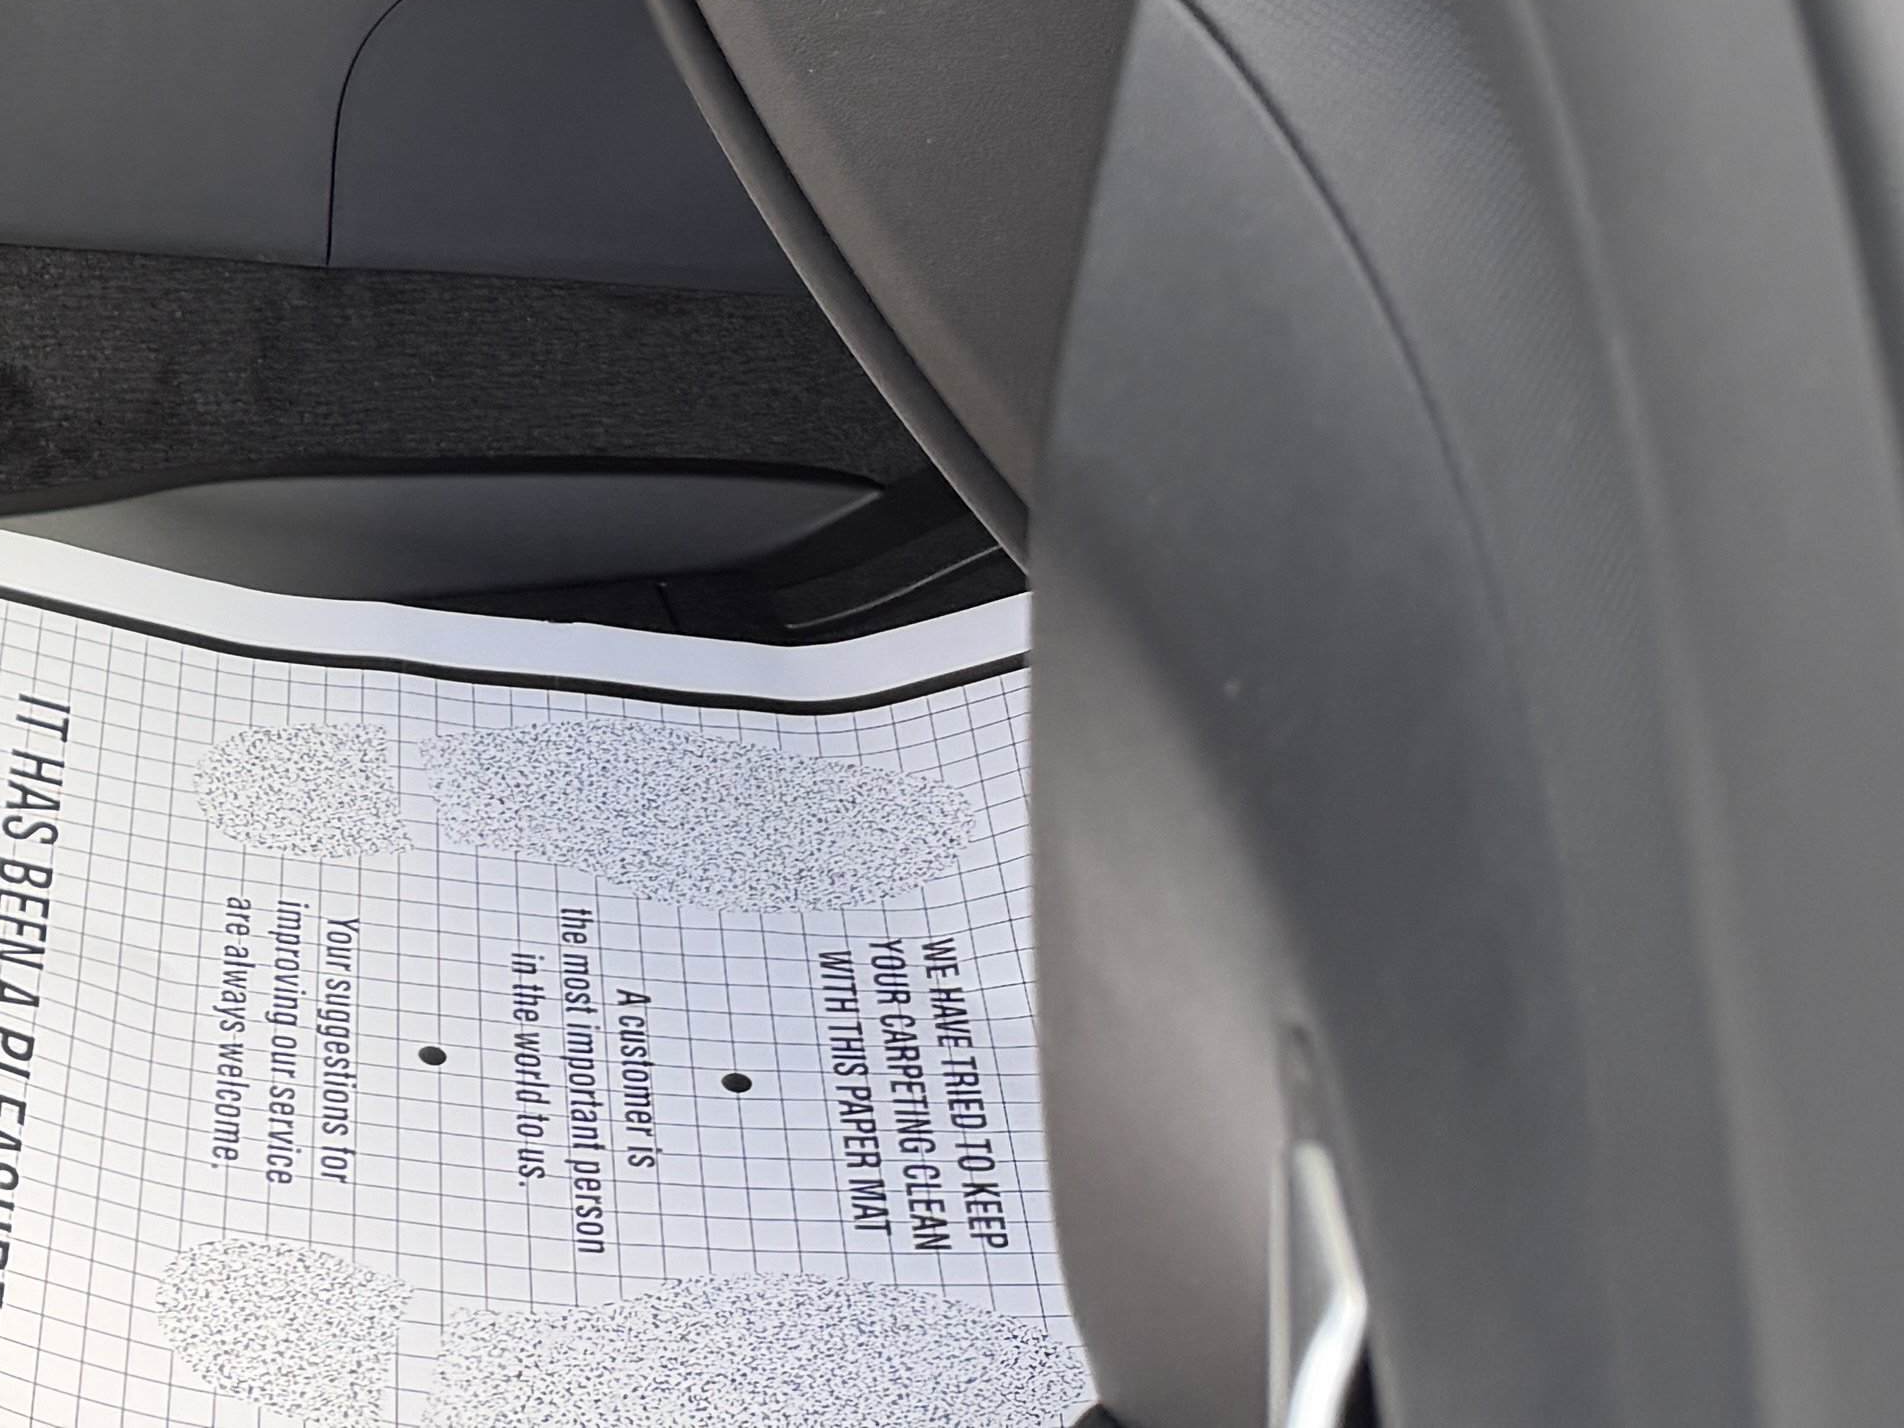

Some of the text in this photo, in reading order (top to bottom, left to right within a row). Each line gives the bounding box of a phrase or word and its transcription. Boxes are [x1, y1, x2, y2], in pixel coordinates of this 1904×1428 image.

[1, 747, 66, 846] HAS
[15, 693, 71, 744] IT
[210, 896, 257, 1169] are always welcome.
[265, 899, 310, 1185] improving our service
[316, 917, 360, 1184] Your suggestions for
[511, 952, 551, 1187] in the world to us.
[559, 907, 605, 1253] the most important person
[616, 988, 663, 1168] A customer is
[818, 950, 891, 1236] WITH THIS PAPER MAT
[869, 938, 952, 1251] YOUR CARPETING CLEAN
[922, 937, 1009, 1249] WE HAVE TRIED TO KEEP
